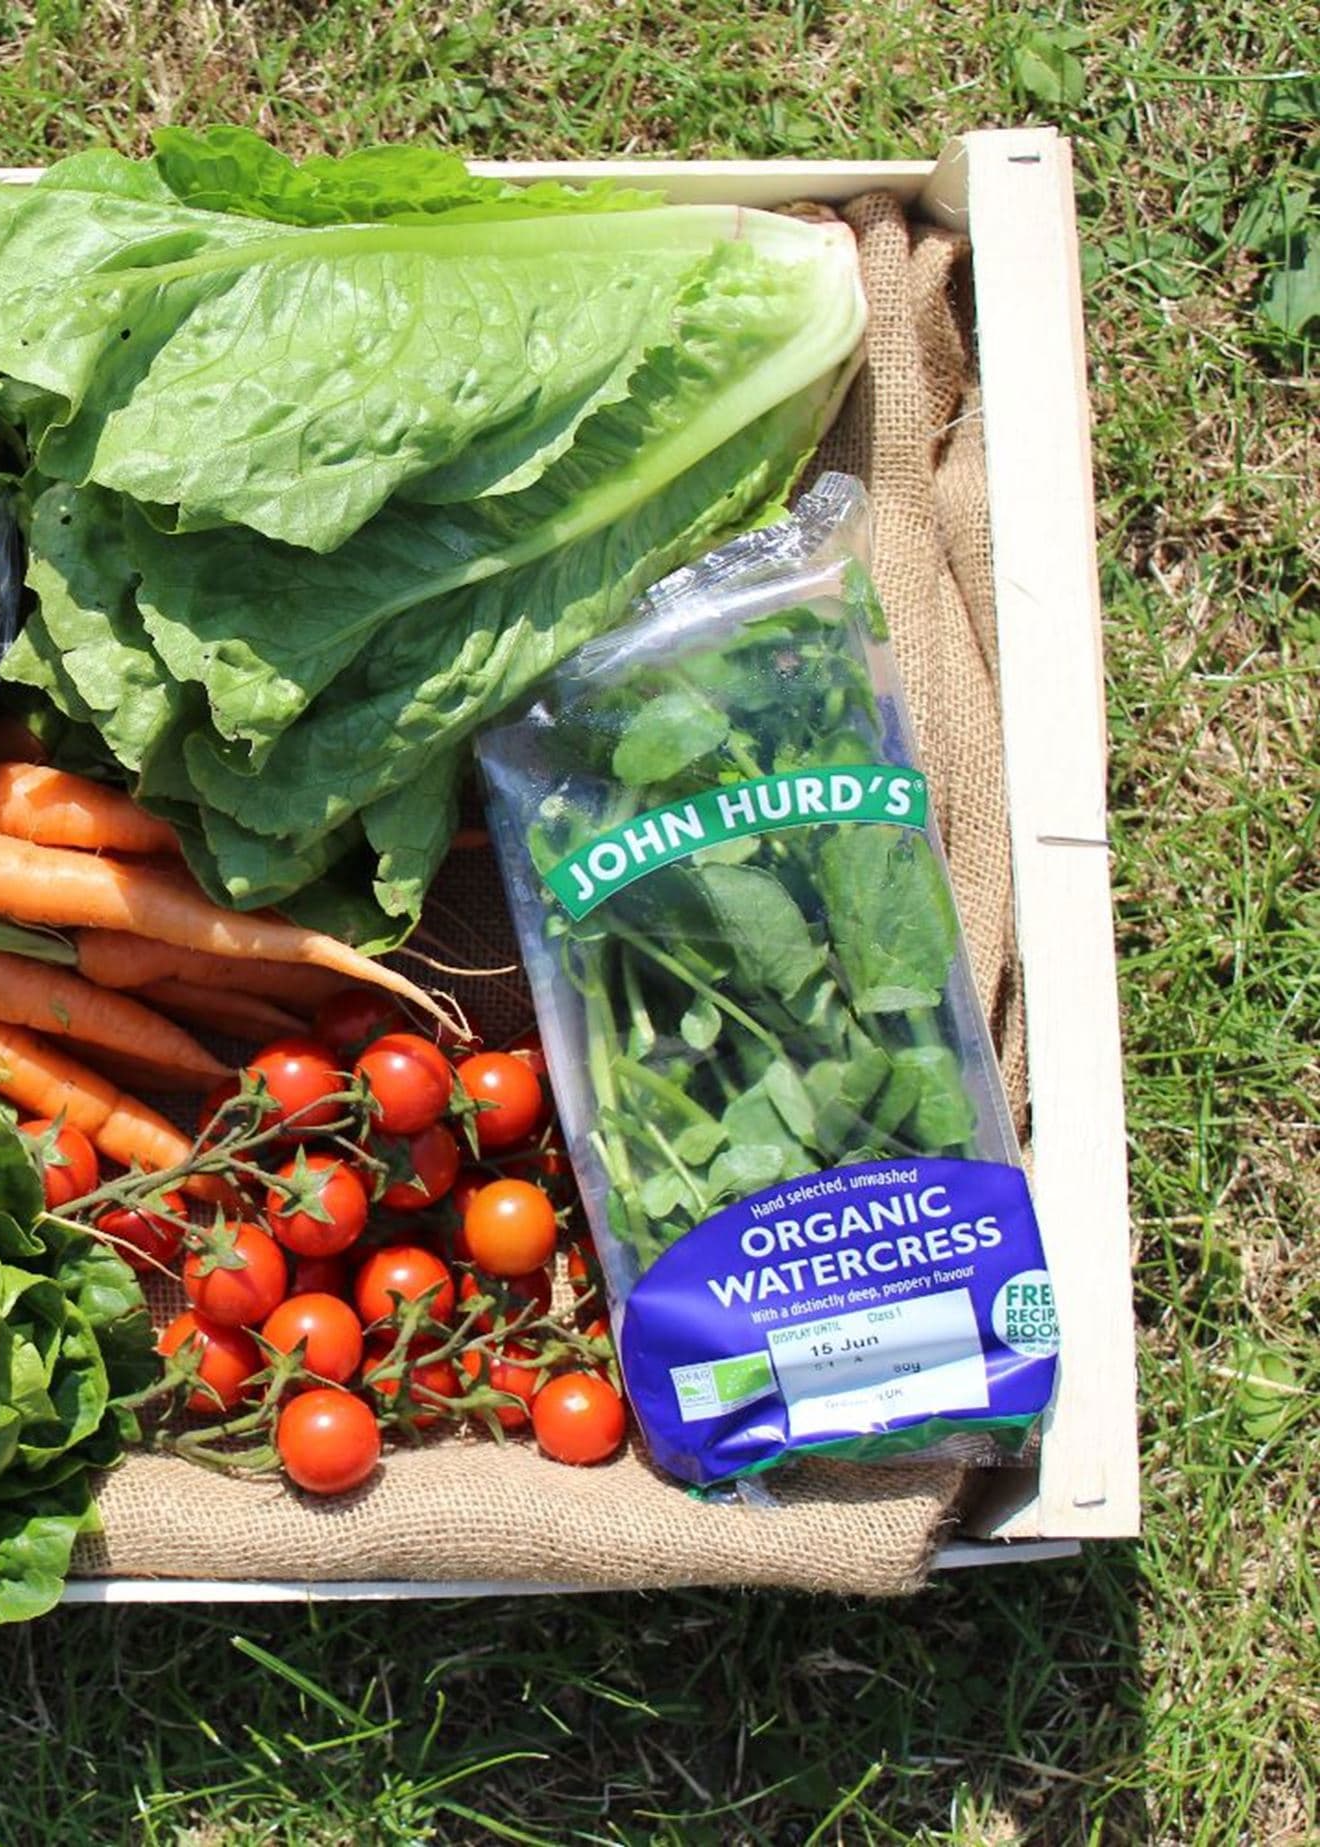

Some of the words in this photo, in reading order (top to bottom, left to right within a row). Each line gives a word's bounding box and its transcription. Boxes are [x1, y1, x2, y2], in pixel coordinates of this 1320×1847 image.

[568, 805, 705, 901] JOHN
[750, 1194, 786, 1220] Hand
[787, 1176, 848, 1206] selected,
[850, 1167, 918, 1189] unwashed
[740, 1186, 952, 1258] ORGANIC
[707, 1216, 1003, 1309] WATERCRESS
[750, 1308, 779, 1325] With
[781, 1307, 790, 1319] a
[790, 1293, 846, 1317] distinctly
[847, 1286, 881, 1304] deep,
[883, 1276, 931, 1298] peppery
[933, 1264, 975, 1284] flavour
[1006, 1284, 1055, 1306] FRE
[1006, 1308, 1057, 1323] RECIP
[771, 1326, 812, 1345] DISPLAY
[813, 1321, 843, 1338] UNTIL
[840, 1335, 880, 1352] Jun
